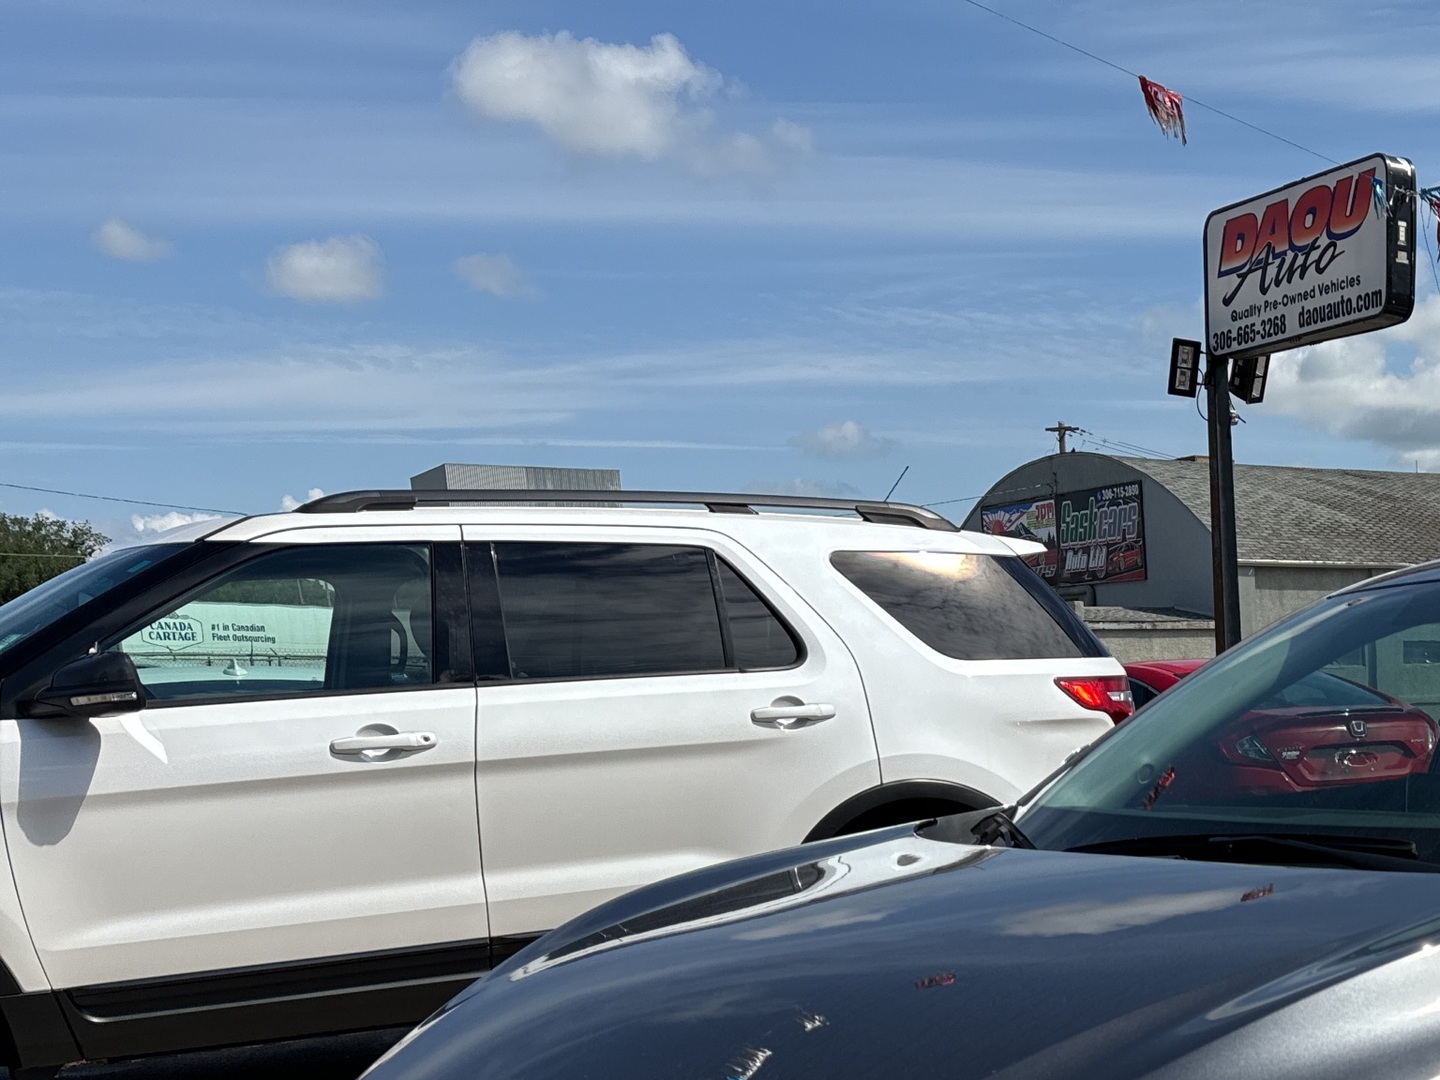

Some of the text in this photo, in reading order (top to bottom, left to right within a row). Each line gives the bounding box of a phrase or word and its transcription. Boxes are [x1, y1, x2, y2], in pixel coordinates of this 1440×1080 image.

[1217, 167, 1377, 279] DAOU
[1221, 236, 1345, 307] Auto
[1230, 274, 1361, 322] Quality Pre-Owned Vehicles
[1213, 288, 1383, 352] 306-665-3268 daouauto.com
[1065, 549, 1088, 573] Auto
[148, 632, 198, 641] CARTAGE
[149, 622, 193, 631] CANADA
[211, 623, 220, 631] #1
[231, 623, 265, 632] Canadian
[212, 633, 276, 644] Fleet Outsourcing
